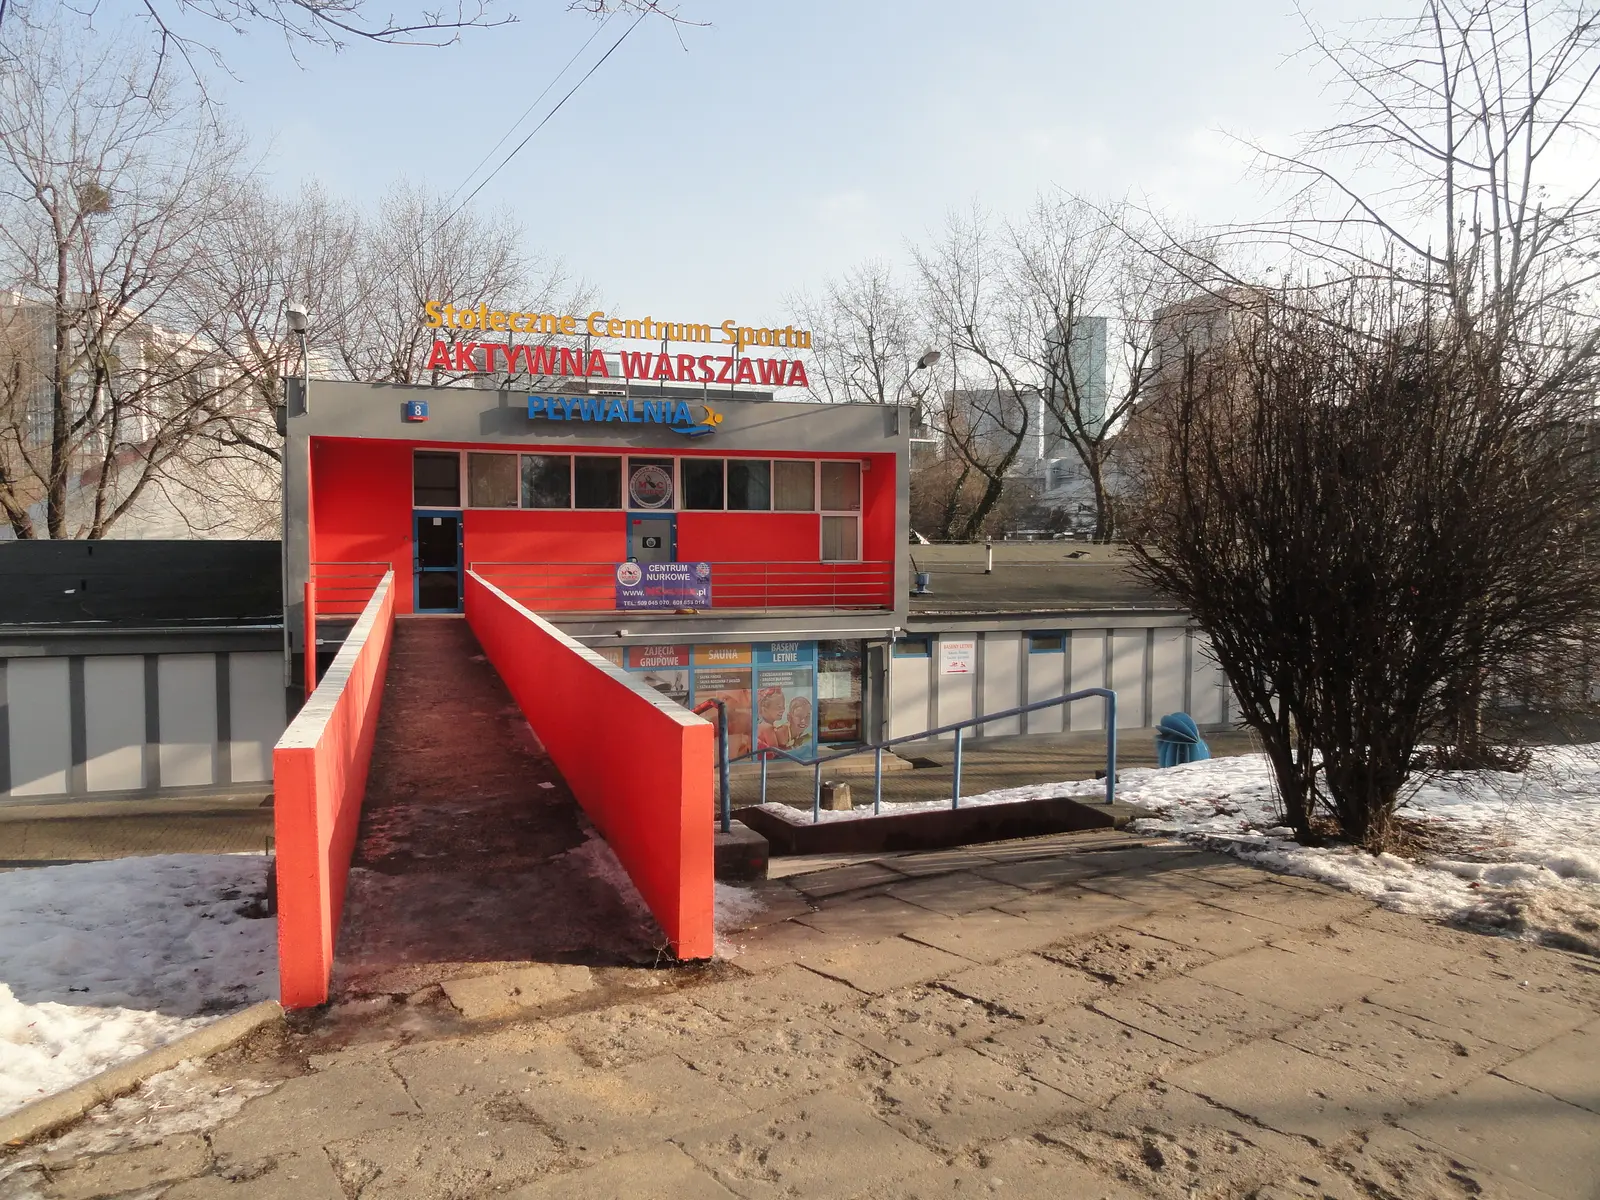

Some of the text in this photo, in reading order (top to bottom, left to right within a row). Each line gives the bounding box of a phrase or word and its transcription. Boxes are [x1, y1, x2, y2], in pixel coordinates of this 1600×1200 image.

[425, 301, 811, 352] Stołeczne Centrum Sportu
[426, 341, 809, 387] AKTYWNA WARSZAWA
[415, 405, 421, 415] 8
[528, 396, 693, 424] PŁYWALNIA
[644, 647, 674, 657] ZAJĘCIA
[771, 643, 798, 652] BASENY
[708, 649, 738, 660] SAUNA
[773, 653, 797, 662] LETNIE
[640, 657, 678, 667] GRUPOWE
